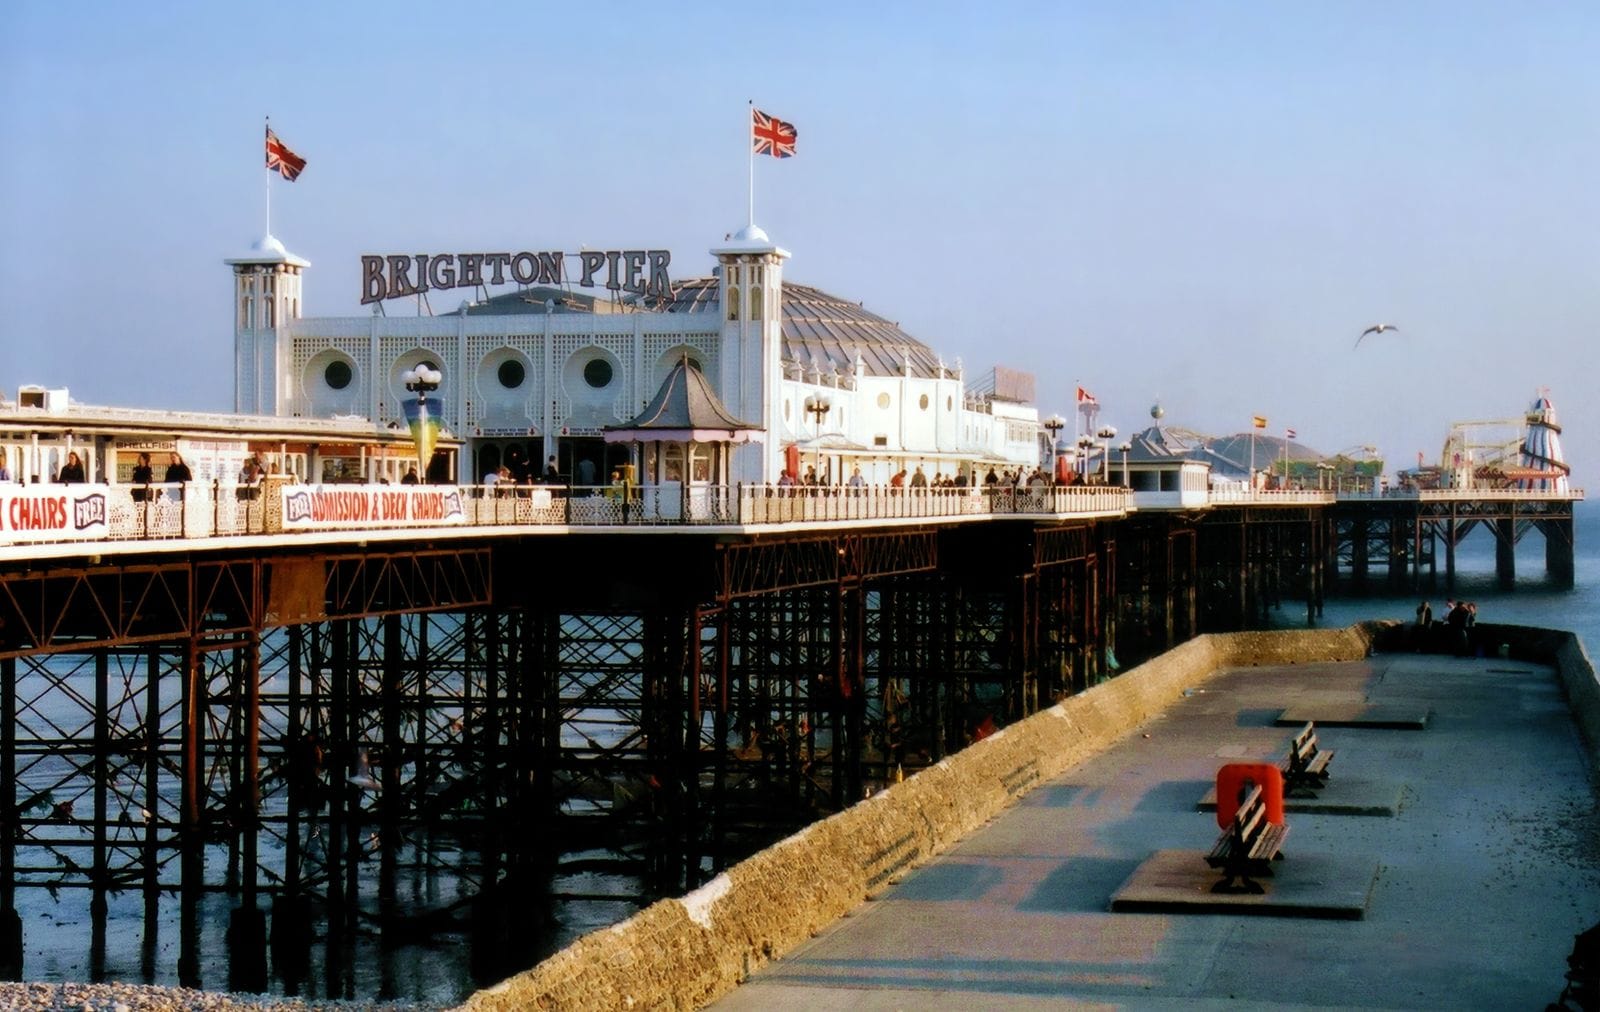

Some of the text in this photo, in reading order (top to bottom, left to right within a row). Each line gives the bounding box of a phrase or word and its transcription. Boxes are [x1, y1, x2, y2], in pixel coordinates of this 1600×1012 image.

[361, 250, 676, 305] BRIGHTON PIER
[9, 496, 67, 531] CHAIRS
[75, 497, 104, 527] FREE
[311, 491, 369, 522] ADMISSION
[371, 492, 380, 520] &
[382, 492, 408, 520] DECK
[411, 492, 443, 520] CHAIRS
